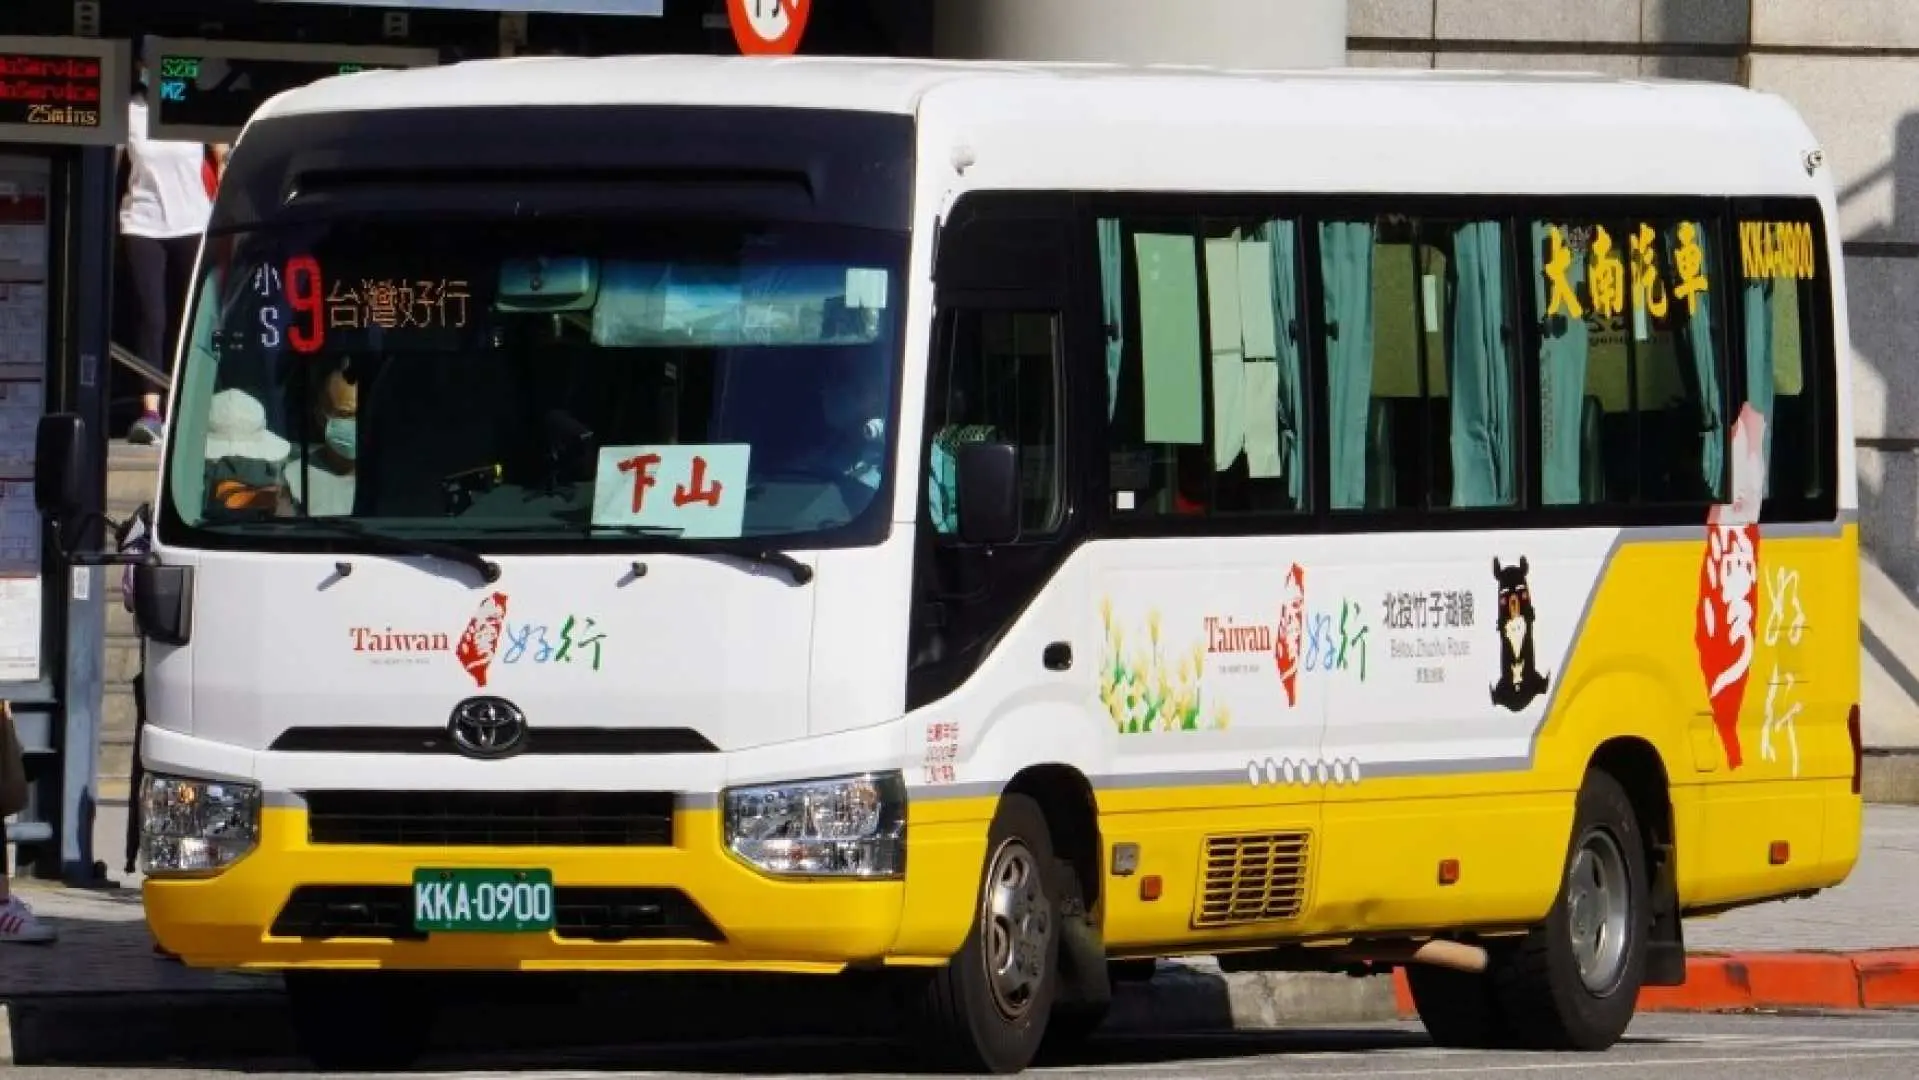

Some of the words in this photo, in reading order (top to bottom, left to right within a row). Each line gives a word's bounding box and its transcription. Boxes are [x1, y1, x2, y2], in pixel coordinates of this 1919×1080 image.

[27, 104, 97, 125] 25mins
[254, 262, 282, 297] 小
[1545, 222, 1708, 319] 大南汽車
[284, 254, 324, 352] 9
[325, 278, 471, 328] 台灣好行
[259, 306, 281, 347] S
[617, 453, 722, 514] 下山
[350, 625, 450, 652] Taiwan
[1204, 615, 1272, 653] Taiwan
[415, 881, 551, 922] KKA-0900
